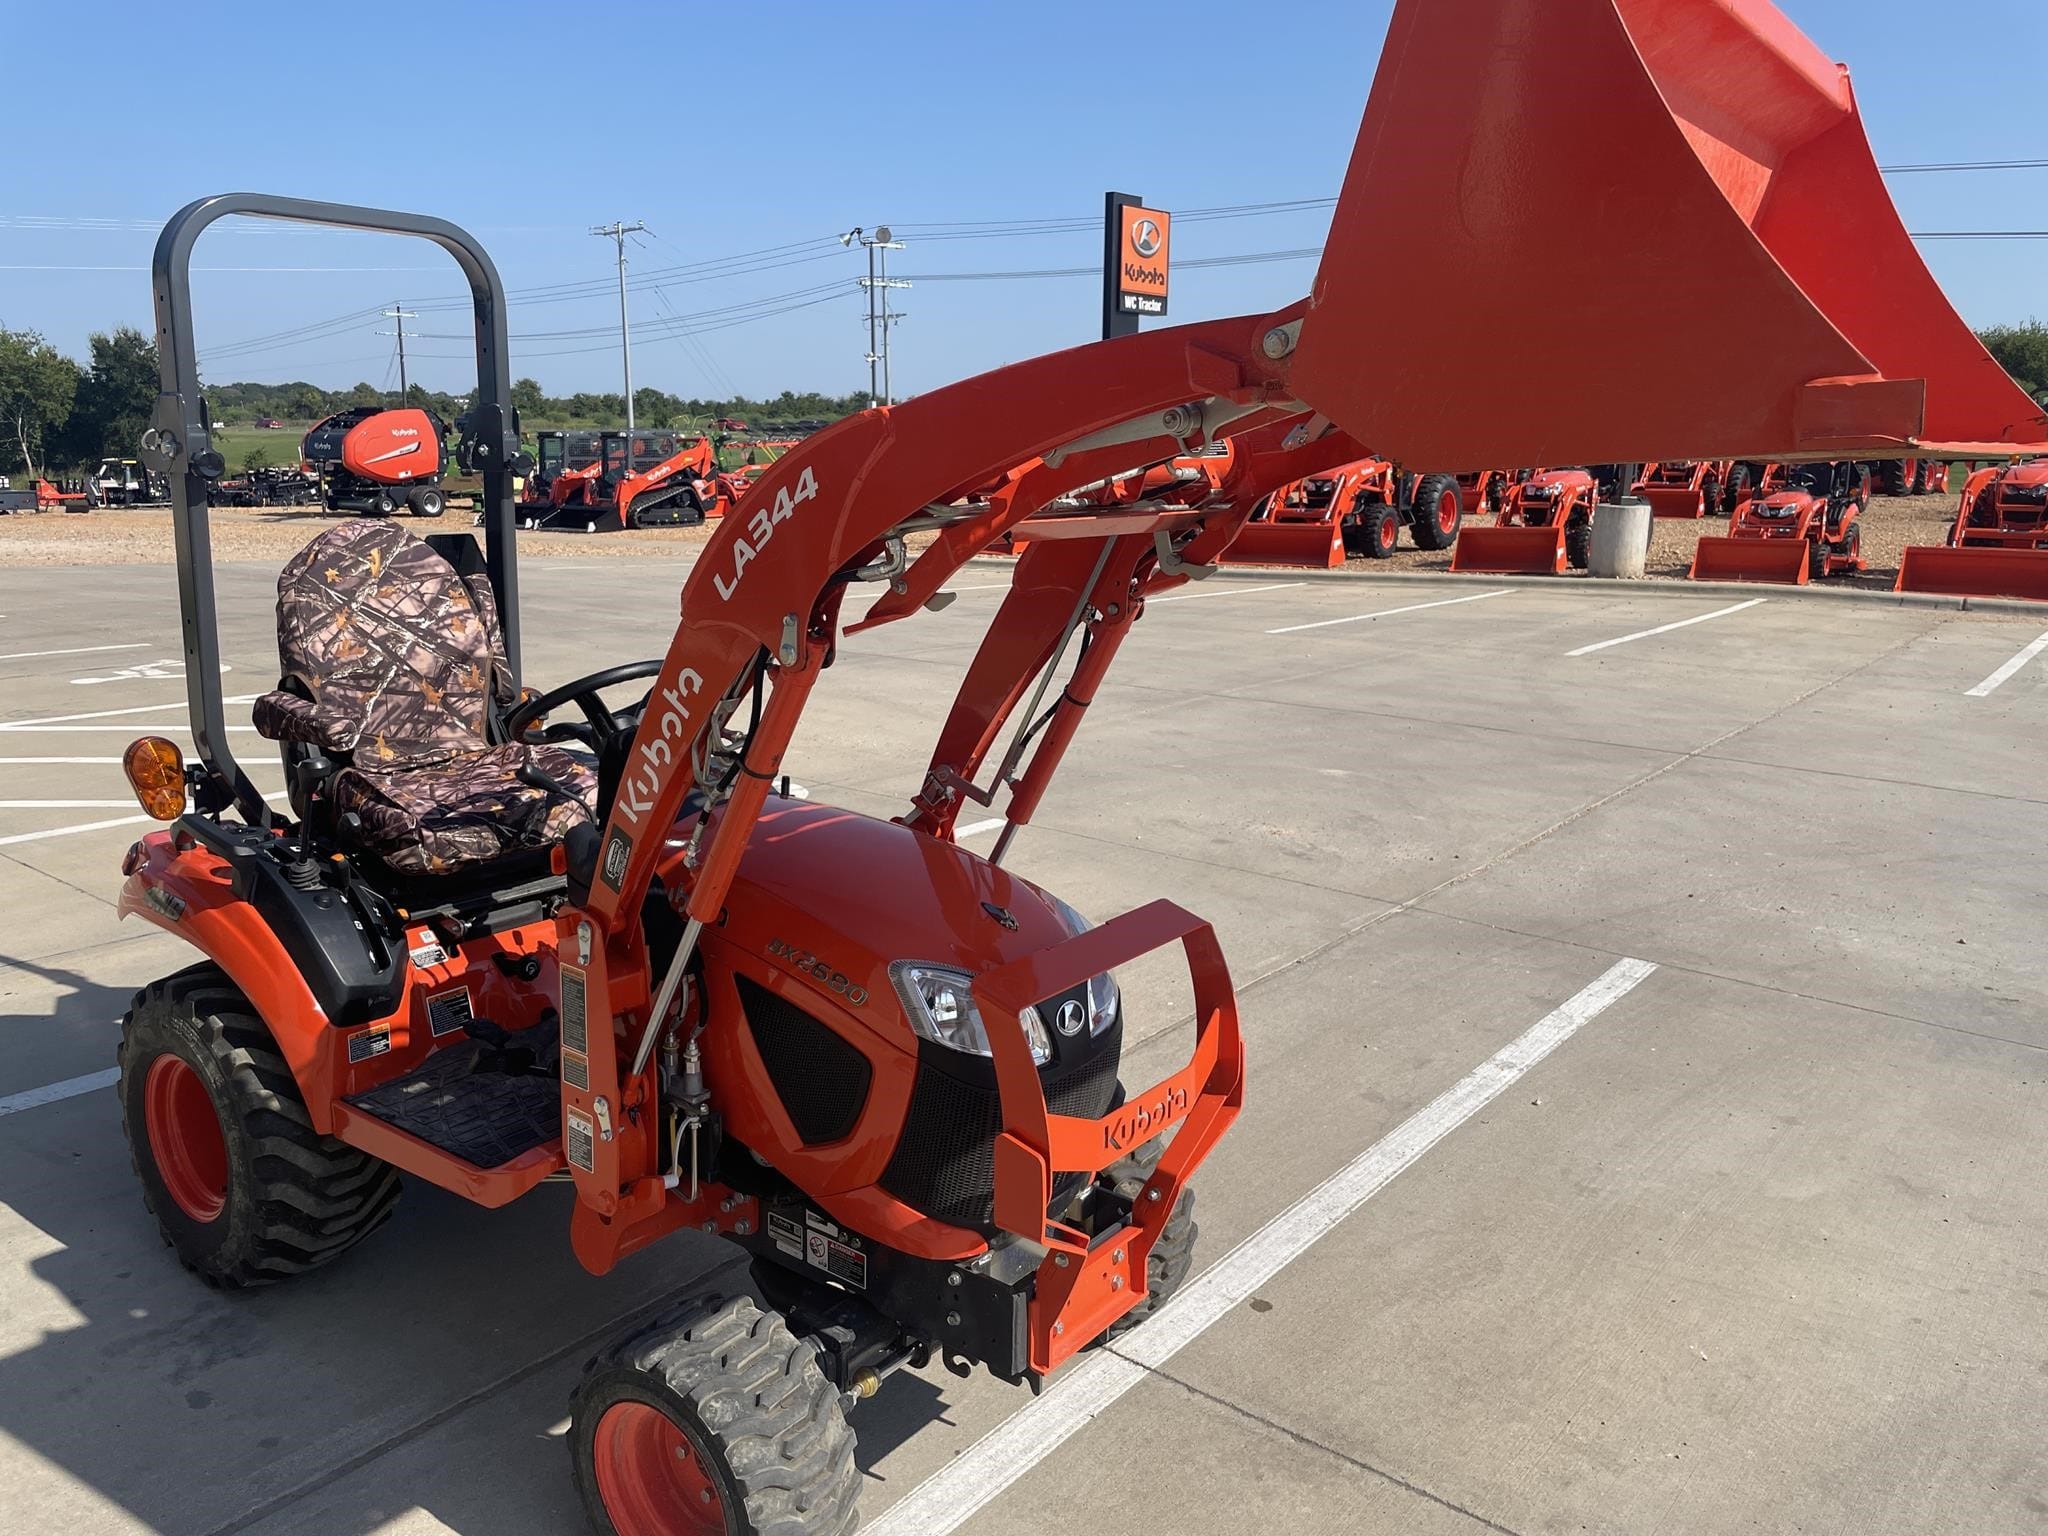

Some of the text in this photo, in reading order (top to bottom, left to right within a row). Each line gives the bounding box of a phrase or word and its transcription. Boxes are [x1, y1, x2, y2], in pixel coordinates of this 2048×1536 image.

[1124, 295, 1162, 312] WC Tractor
[1125, 263, 1165, 286] Kubota
[713, 466, 820, 601] LA344
[618, 667, 704, 823] Kubota
[1105, 1087, 1187, 1150] Kubota
